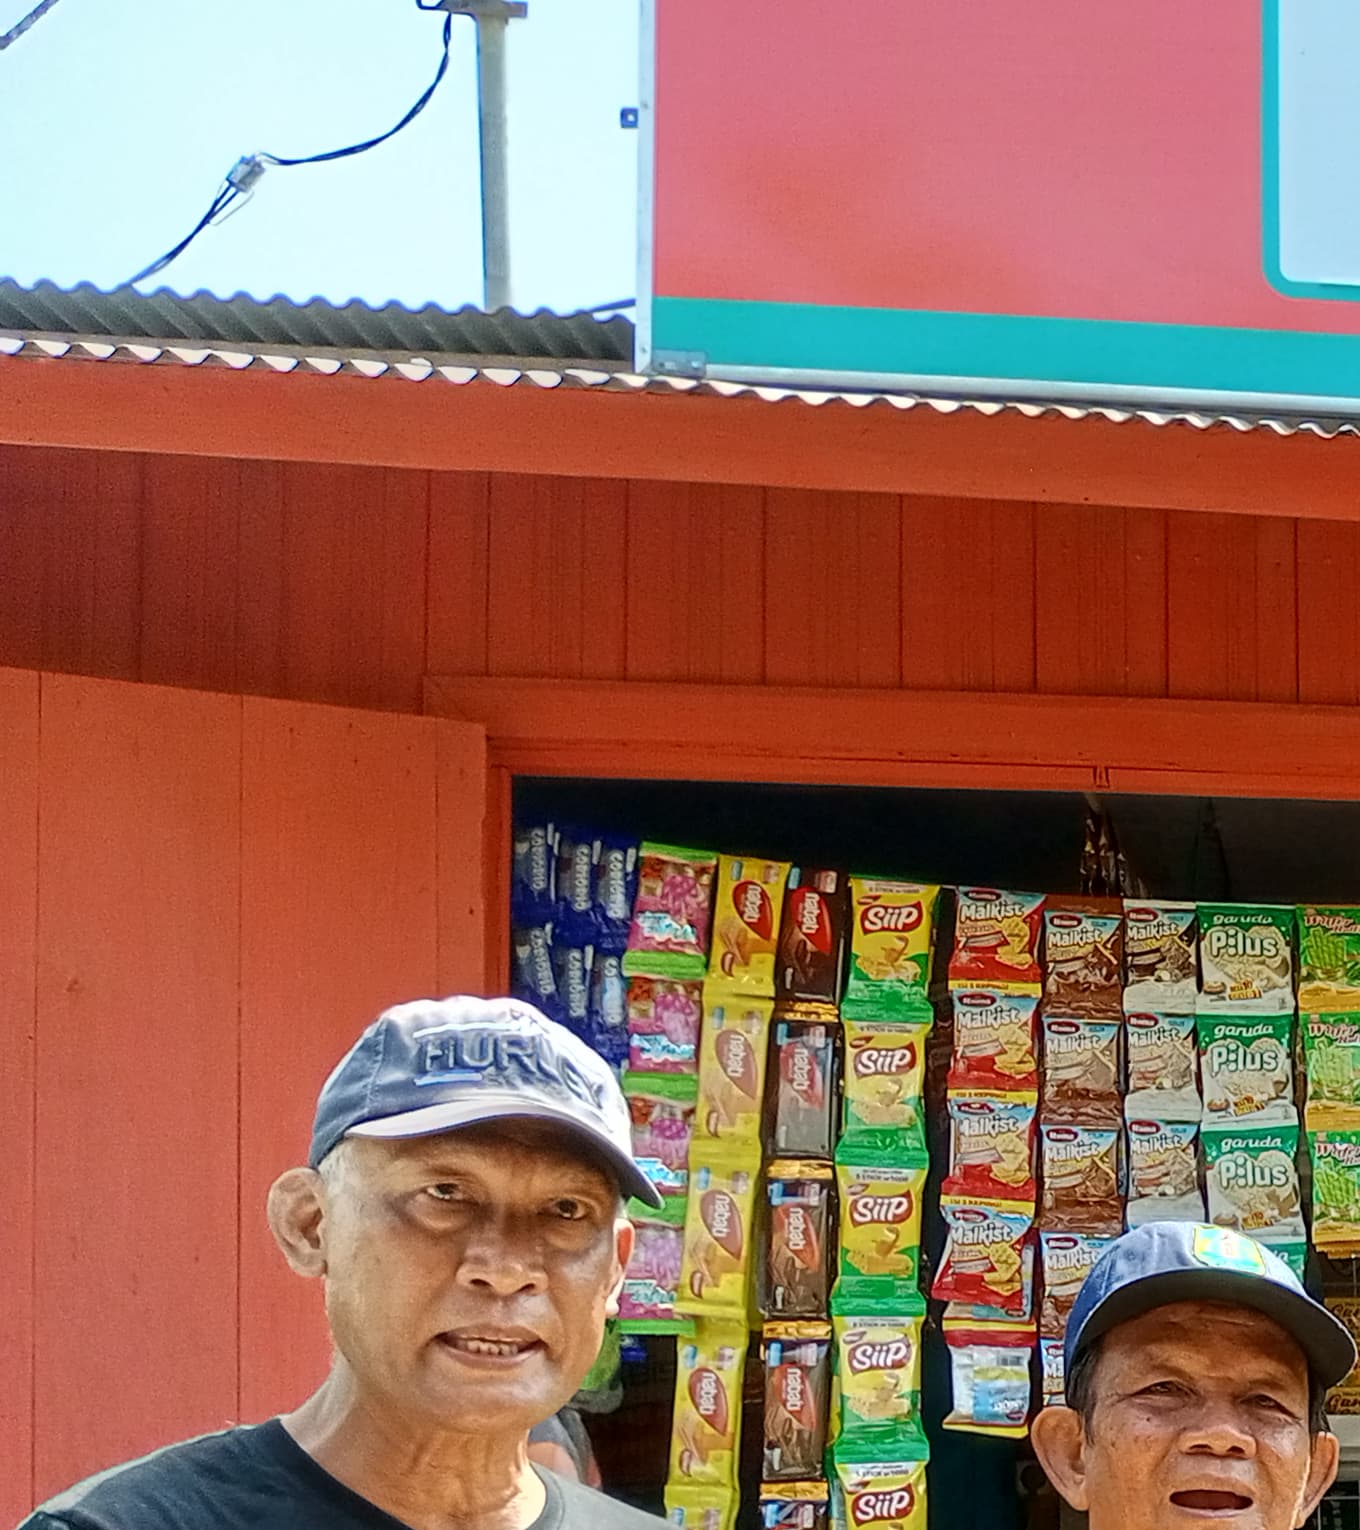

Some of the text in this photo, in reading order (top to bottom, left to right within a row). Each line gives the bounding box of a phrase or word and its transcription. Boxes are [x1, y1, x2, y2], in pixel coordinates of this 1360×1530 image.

[960, 899, 1025, 923] Malkist
[1048, 925, 1103, 948] Malkist
[1210, 931, 1278, 958] Pilus
[957, 1006, 1021, 1031] Malkist
[1212, 1044, 1278, 1072] Pilus
[1219, 1159, 1288, 1188] Pilus
